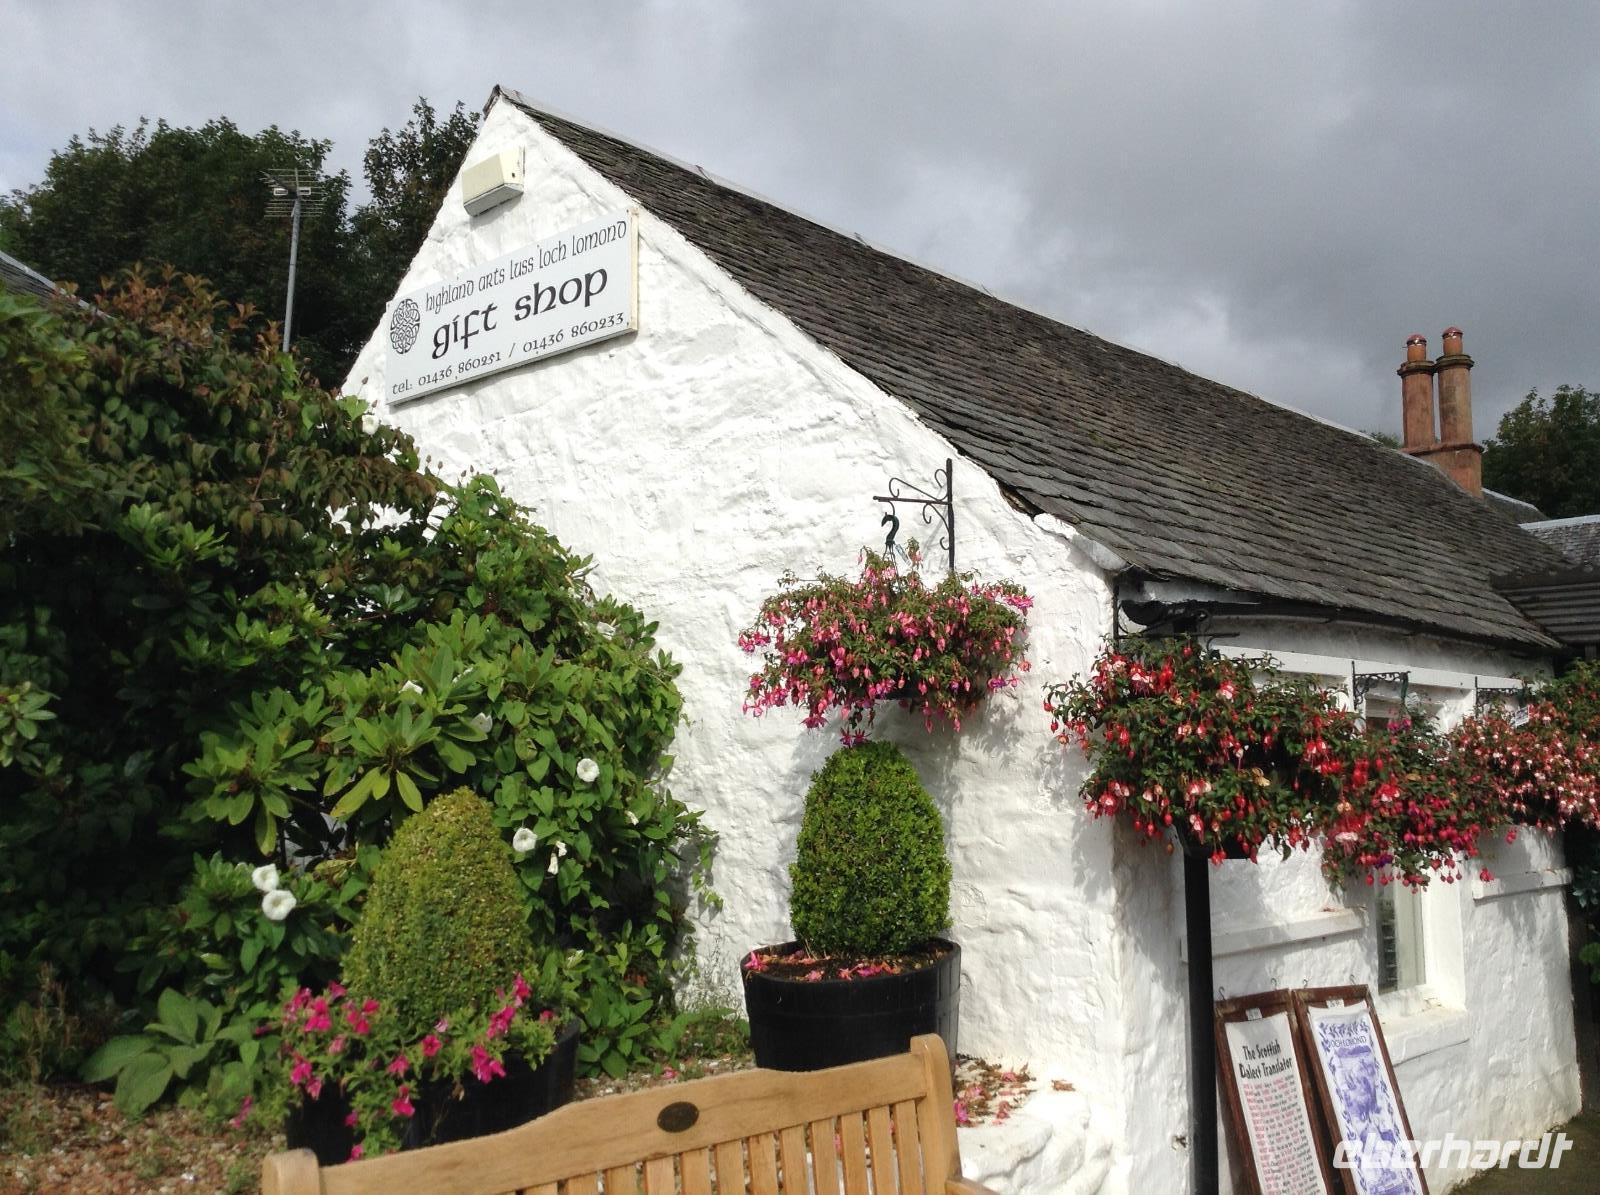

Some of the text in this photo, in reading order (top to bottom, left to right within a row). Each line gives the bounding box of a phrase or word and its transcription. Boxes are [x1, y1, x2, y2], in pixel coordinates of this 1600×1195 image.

[426, 220, 627, 314] highland arts luss loch lomond
[392, 312, 624, 395] tel: 01436 860251 / 01436 860233
[432, 268, 608, 359] gift shop
[1242, 1038, 1281, 1060] The Scottish
[1261, 1057, 1292, 1077] Translator
